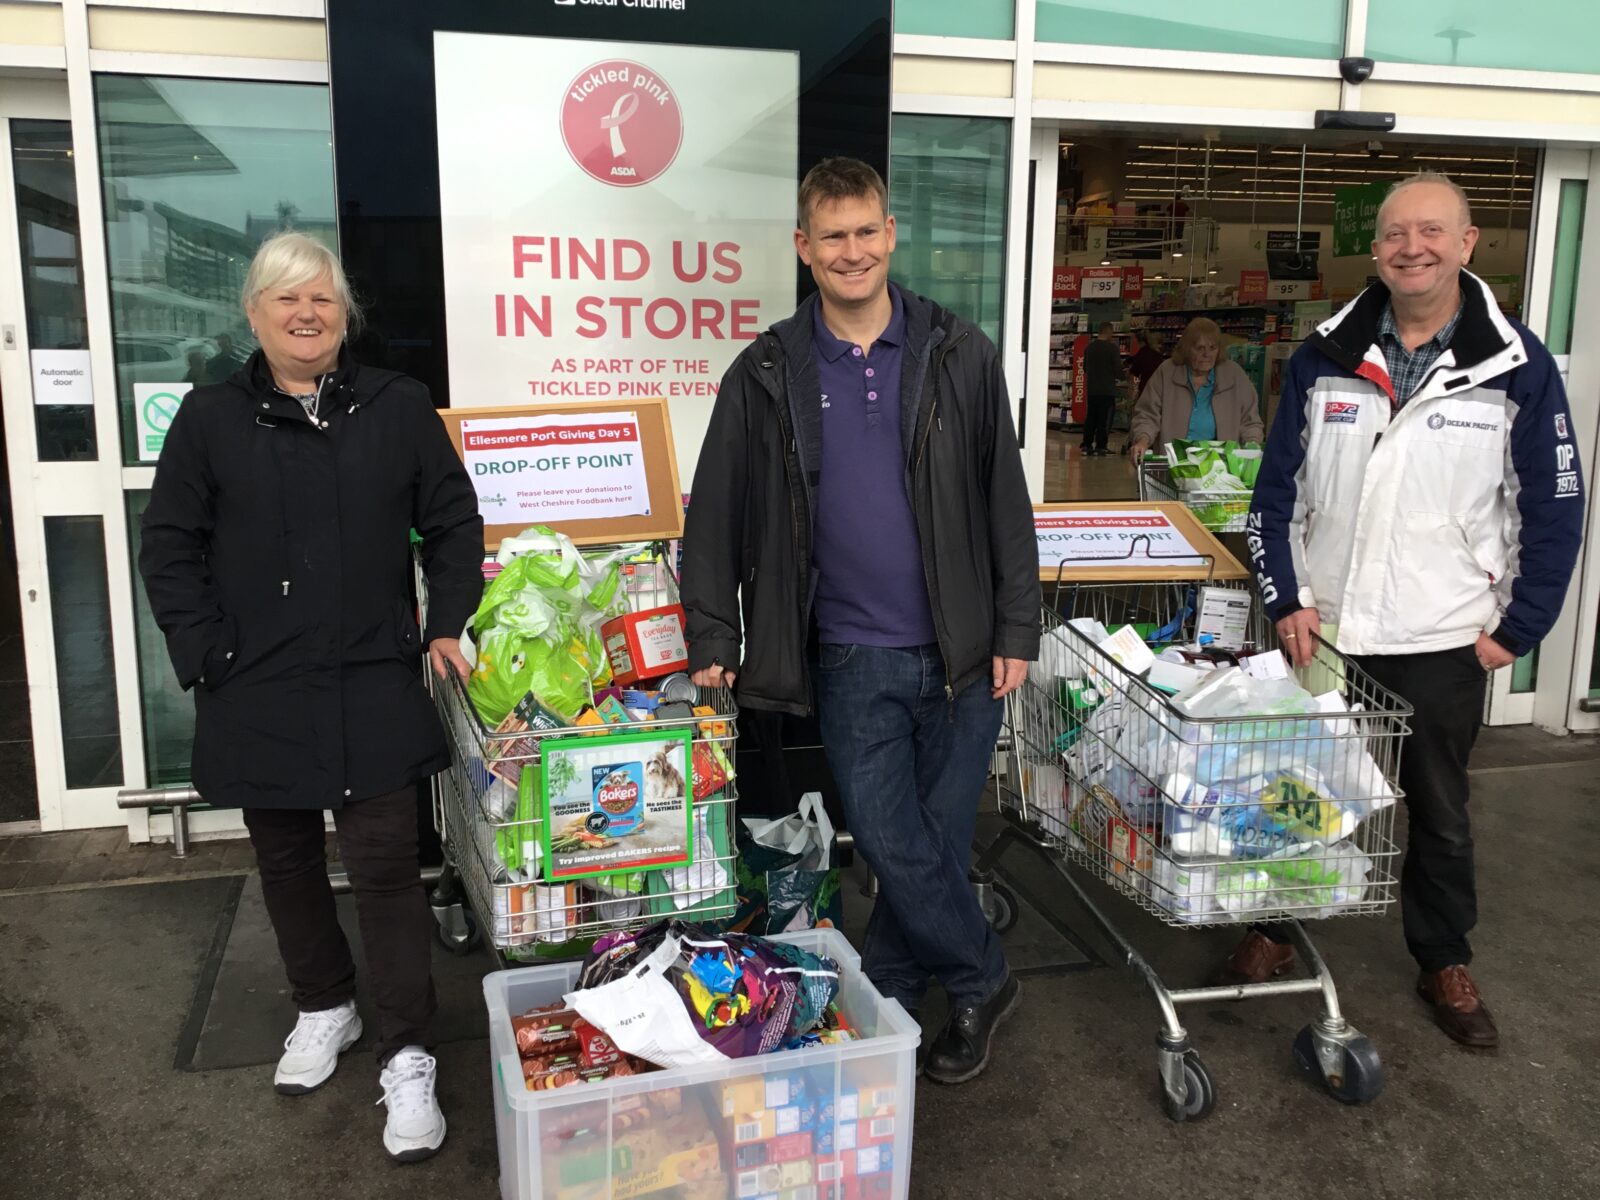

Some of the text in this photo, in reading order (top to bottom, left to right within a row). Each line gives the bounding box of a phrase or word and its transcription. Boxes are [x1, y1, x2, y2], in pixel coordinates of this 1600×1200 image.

[571, 66, 670, 106] tickled pink
[610, 166, 637, 177] ASDA
[512, 235, 743, 284] FIND US
[1056, 274, 1075, 282] Roll
[1054, 282, 1077, 290] Back
[495, 294, 761, 341] IN STORE
[40, 368, 84, 376] Automatic
[551, 358, 709, 374] AS PART OF THE
[53, 378, 73, 386] door
[1074, 356, 1085, 403] RollBack
[528, 380, 611, 396] TICKLED
[618, 381, 663, 396] PINK
[1446, 419, 1499, 431] OCEAN PACIFIC
[469, 427, 631, 446] Ellesmere Port Giving Day 5
[474, 453, 634, 476] DROP-OFF POINT
[1556, 444, 1574, 471] OP
[1556, 475, 1579, 493] 1972
[517, 489, 542, 498] Please
[543, 487, 564, 496] leave
[566, 488, 583, 496] your
[585, 485, 623, 494] donations
[519, 495, 633, 509] West Cheshire Foodbank here
[1094, 518, 1130, 526] Giving
[1131, 518, 1152, 527] Day
[643, 624, 676, 638] Everyday
[593, 767, 610, 775] NEW
[599, 786, 638, 803] Bakers
[555, 807, 591, 817] GOODNESS
[650, 804, 682, 813] TASTINESS
[574, 851, 617, 864] improved
[618, 847, 652, 858] BAKERS
[654, 844, 681, 854] recipe
